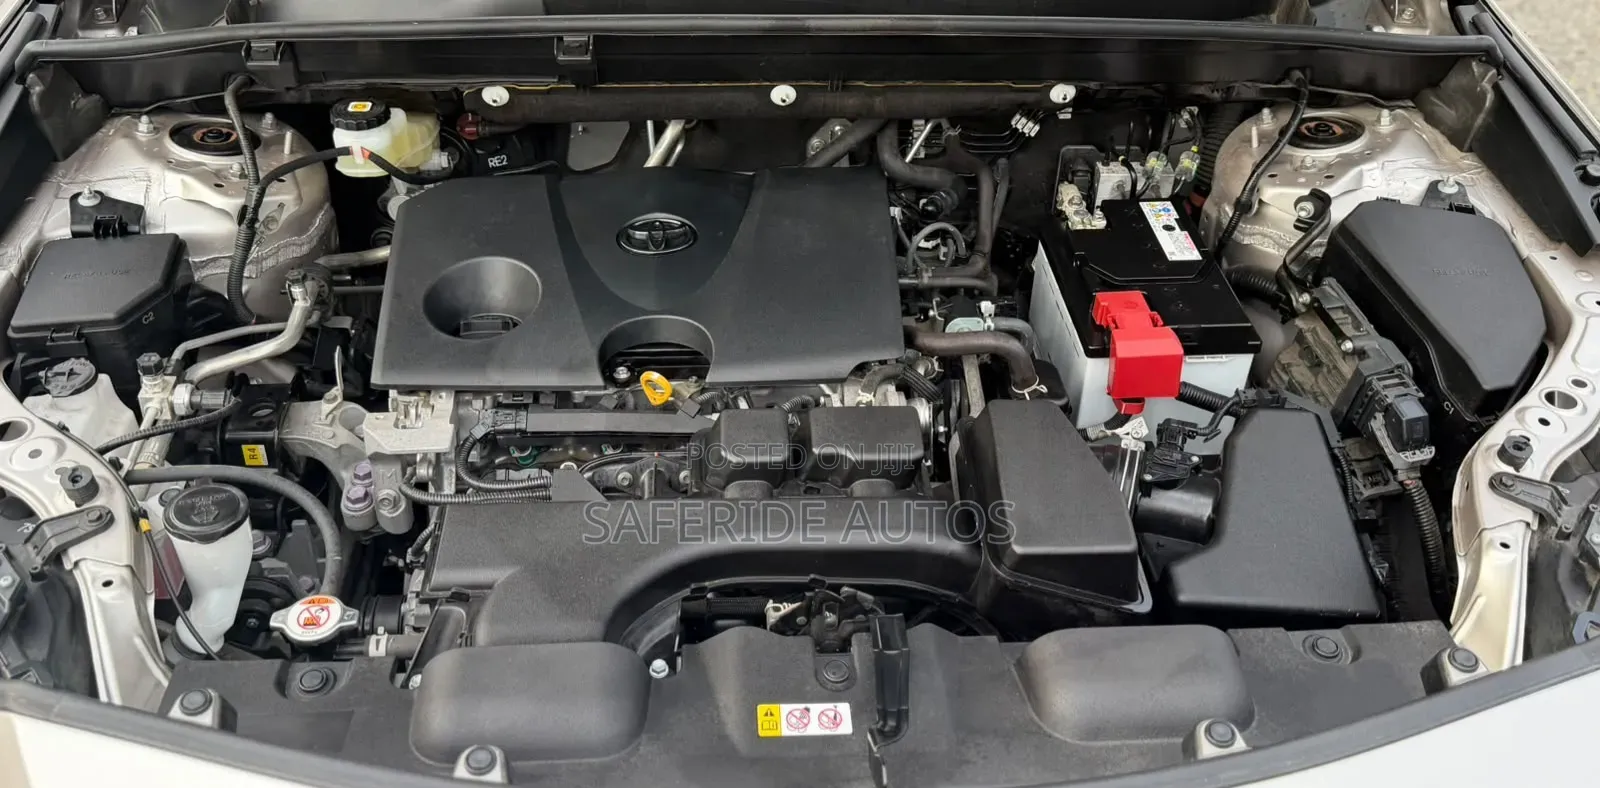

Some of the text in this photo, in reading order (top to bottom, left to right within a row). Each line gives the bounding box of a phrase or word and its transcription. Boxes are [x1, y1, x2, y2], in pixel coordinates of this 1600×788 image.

[488, 154, 508, 168] RE2
[142, 311, 155, 325] C2
[1443, 401, 1454, 415] C1
[247, 448, 259, 460] R4
